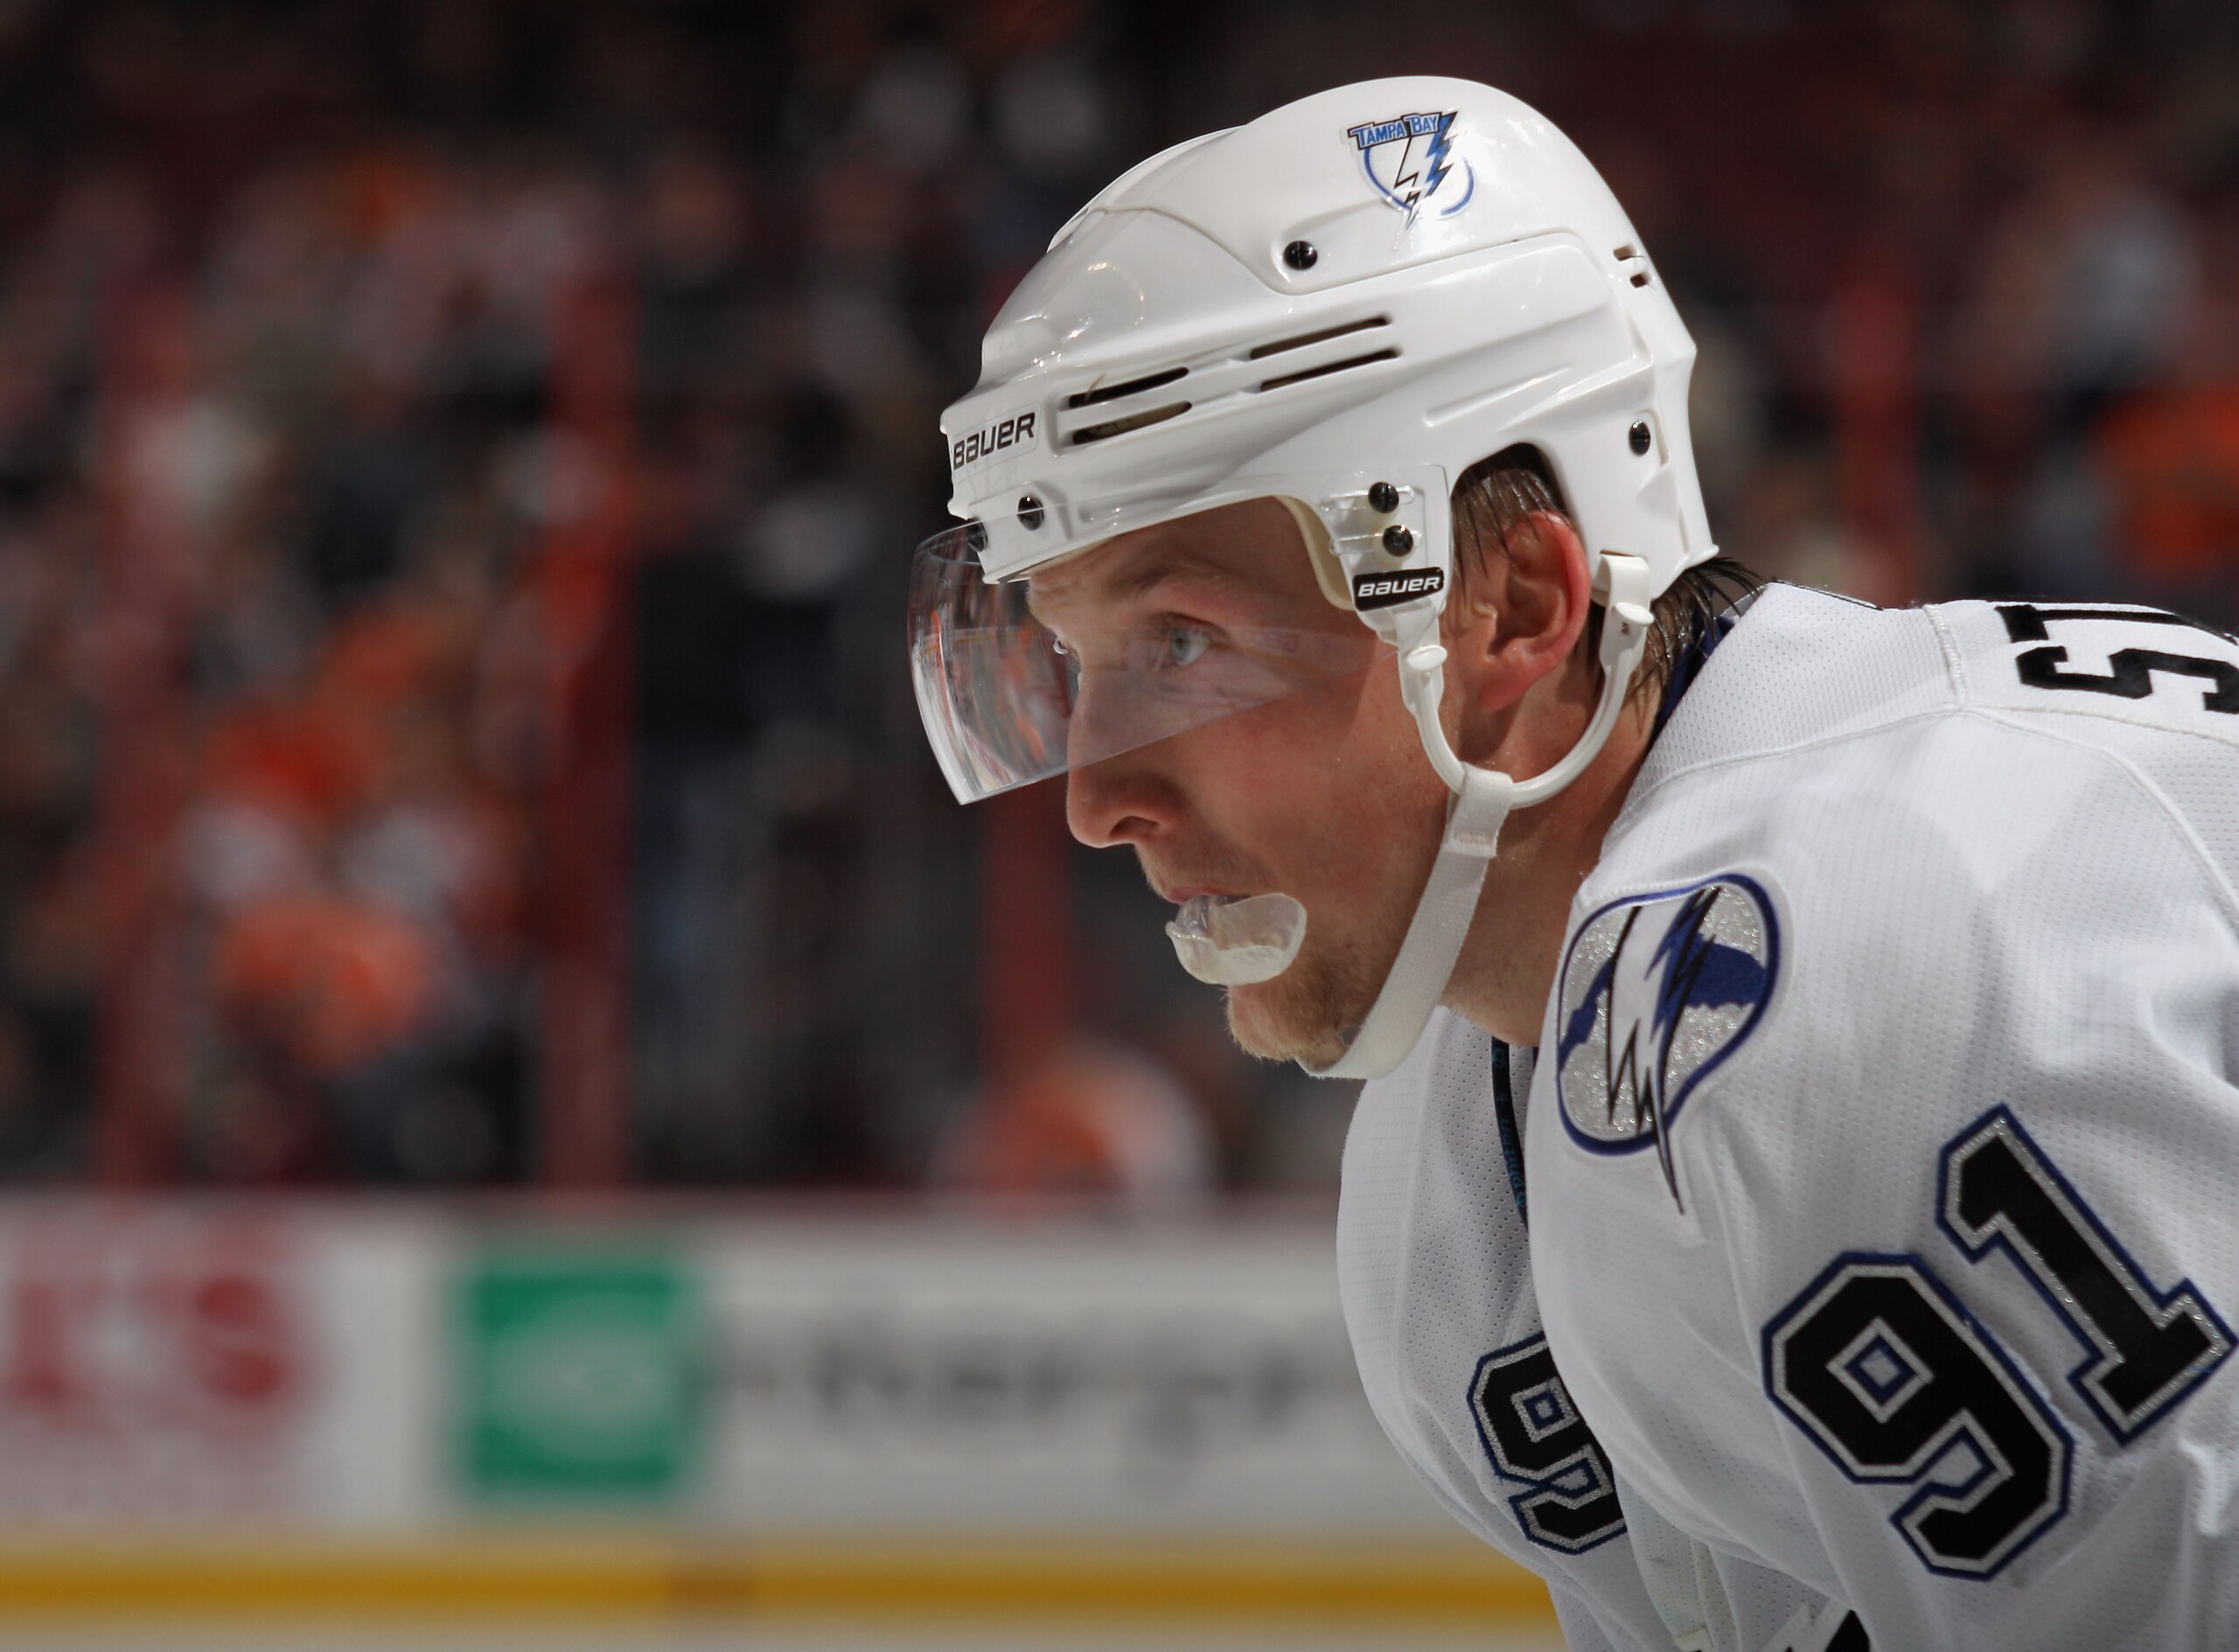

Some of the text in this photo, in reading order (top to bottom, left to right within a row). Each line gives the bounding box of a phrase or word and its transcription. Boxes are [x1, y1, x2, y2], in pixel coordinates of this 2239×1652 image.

[1350, 115, 1439, 147] TAMPA BAY
[953, 412, 1036, 471] BAUER
[1357, 576, 1440, 597] BAUER
[1761, 1104, 2239, 1581] 91
